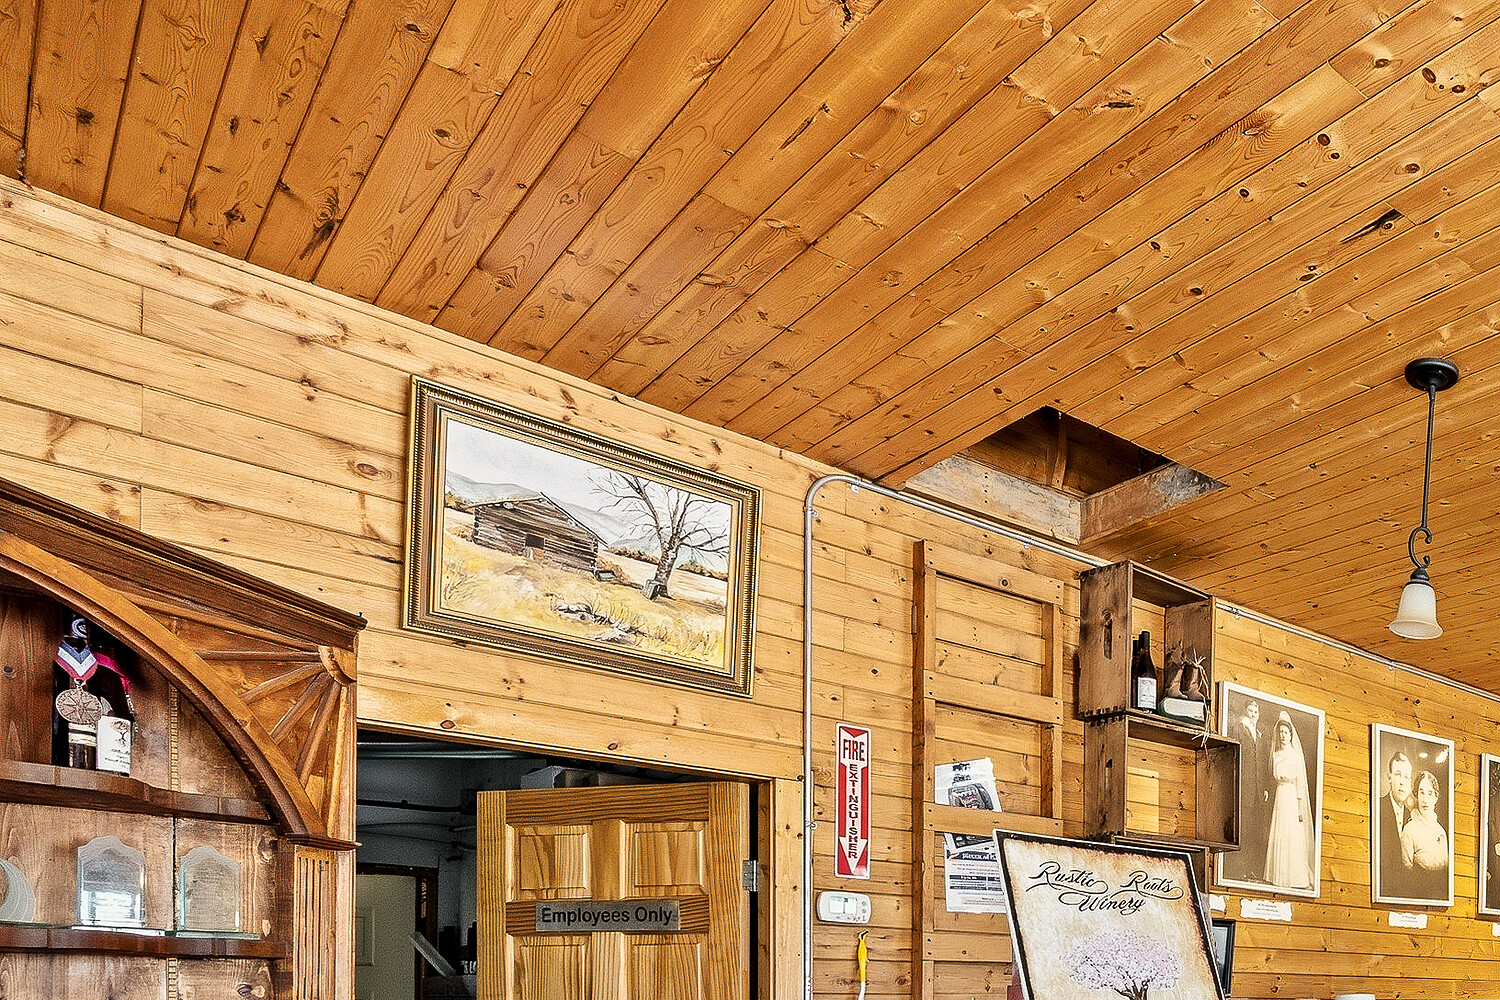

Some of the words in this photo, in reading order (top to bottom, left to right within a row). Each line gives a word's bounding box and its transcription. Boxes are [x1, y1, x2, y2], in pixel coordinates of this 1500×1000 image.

[843, 738, 865, 761] FIRE
[848, 764, 858, 858] EXTINGUISHER
[1026, 861, 1108, 894] Rustic
[1114, 871, 1184, 900] Roots
[1059, 892, 1147, 915] Winery
[541, 907, 630, 926] Employees
[635, 906, 673, 926] Only
